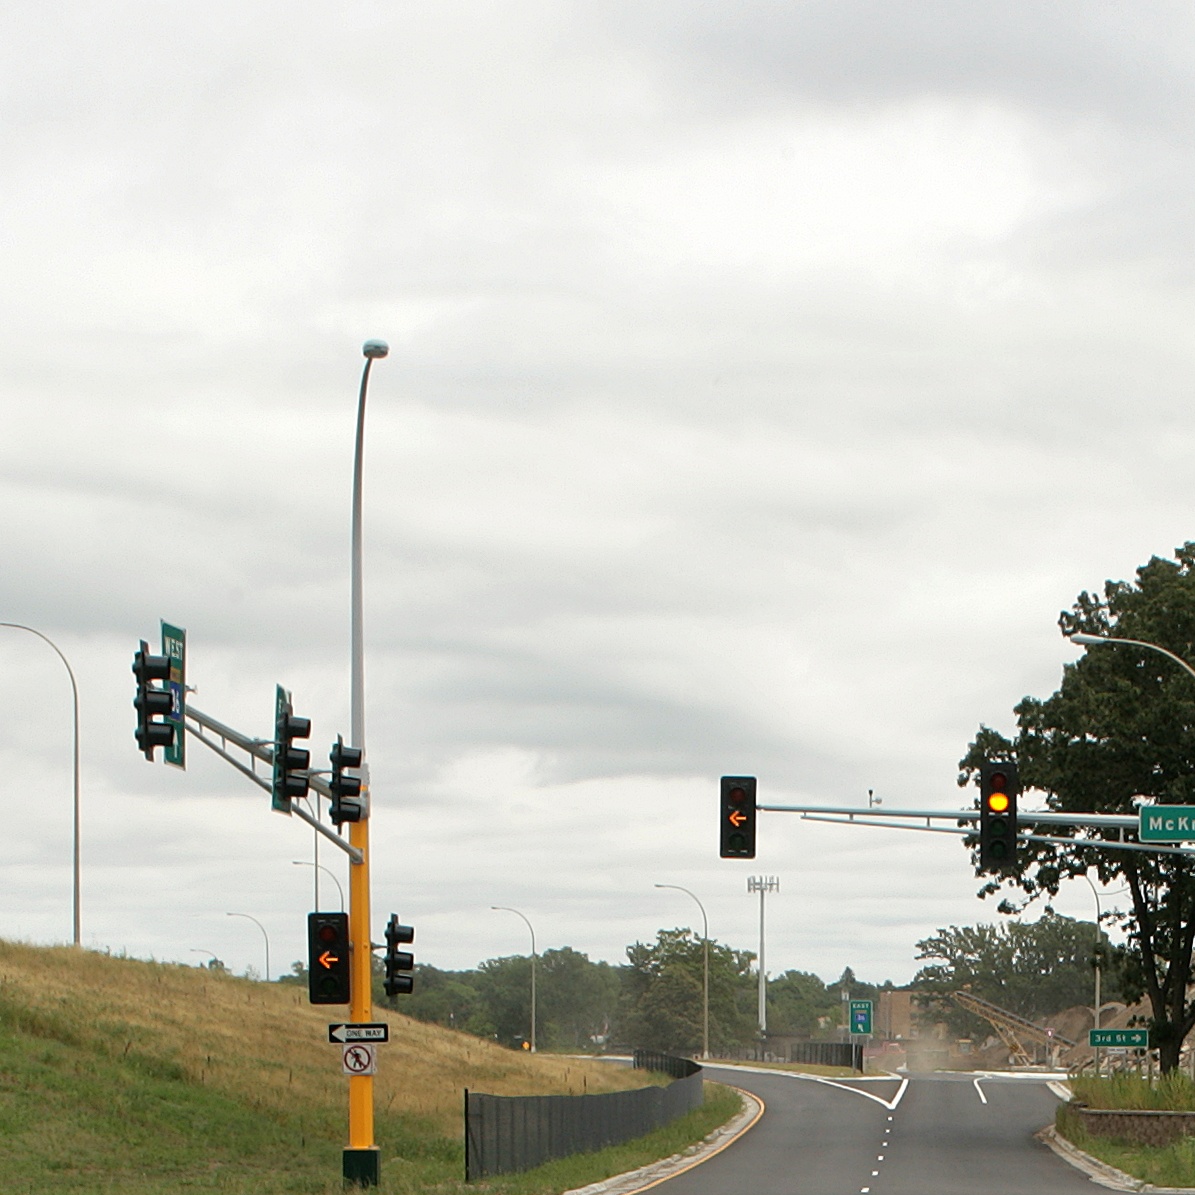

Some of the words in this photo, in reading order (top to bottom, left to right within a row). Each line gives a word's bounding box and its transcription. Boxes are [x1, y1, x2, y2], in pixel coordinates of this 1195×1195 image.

[164, 636, 183, 660] WEST
[346, 1029, 361, 1037] ONE
[365, 1029, 382, 1037] WAY
[1094, 1034, 1111, 1042] 3rd
[1115, 1034, 1126, 1042] St
